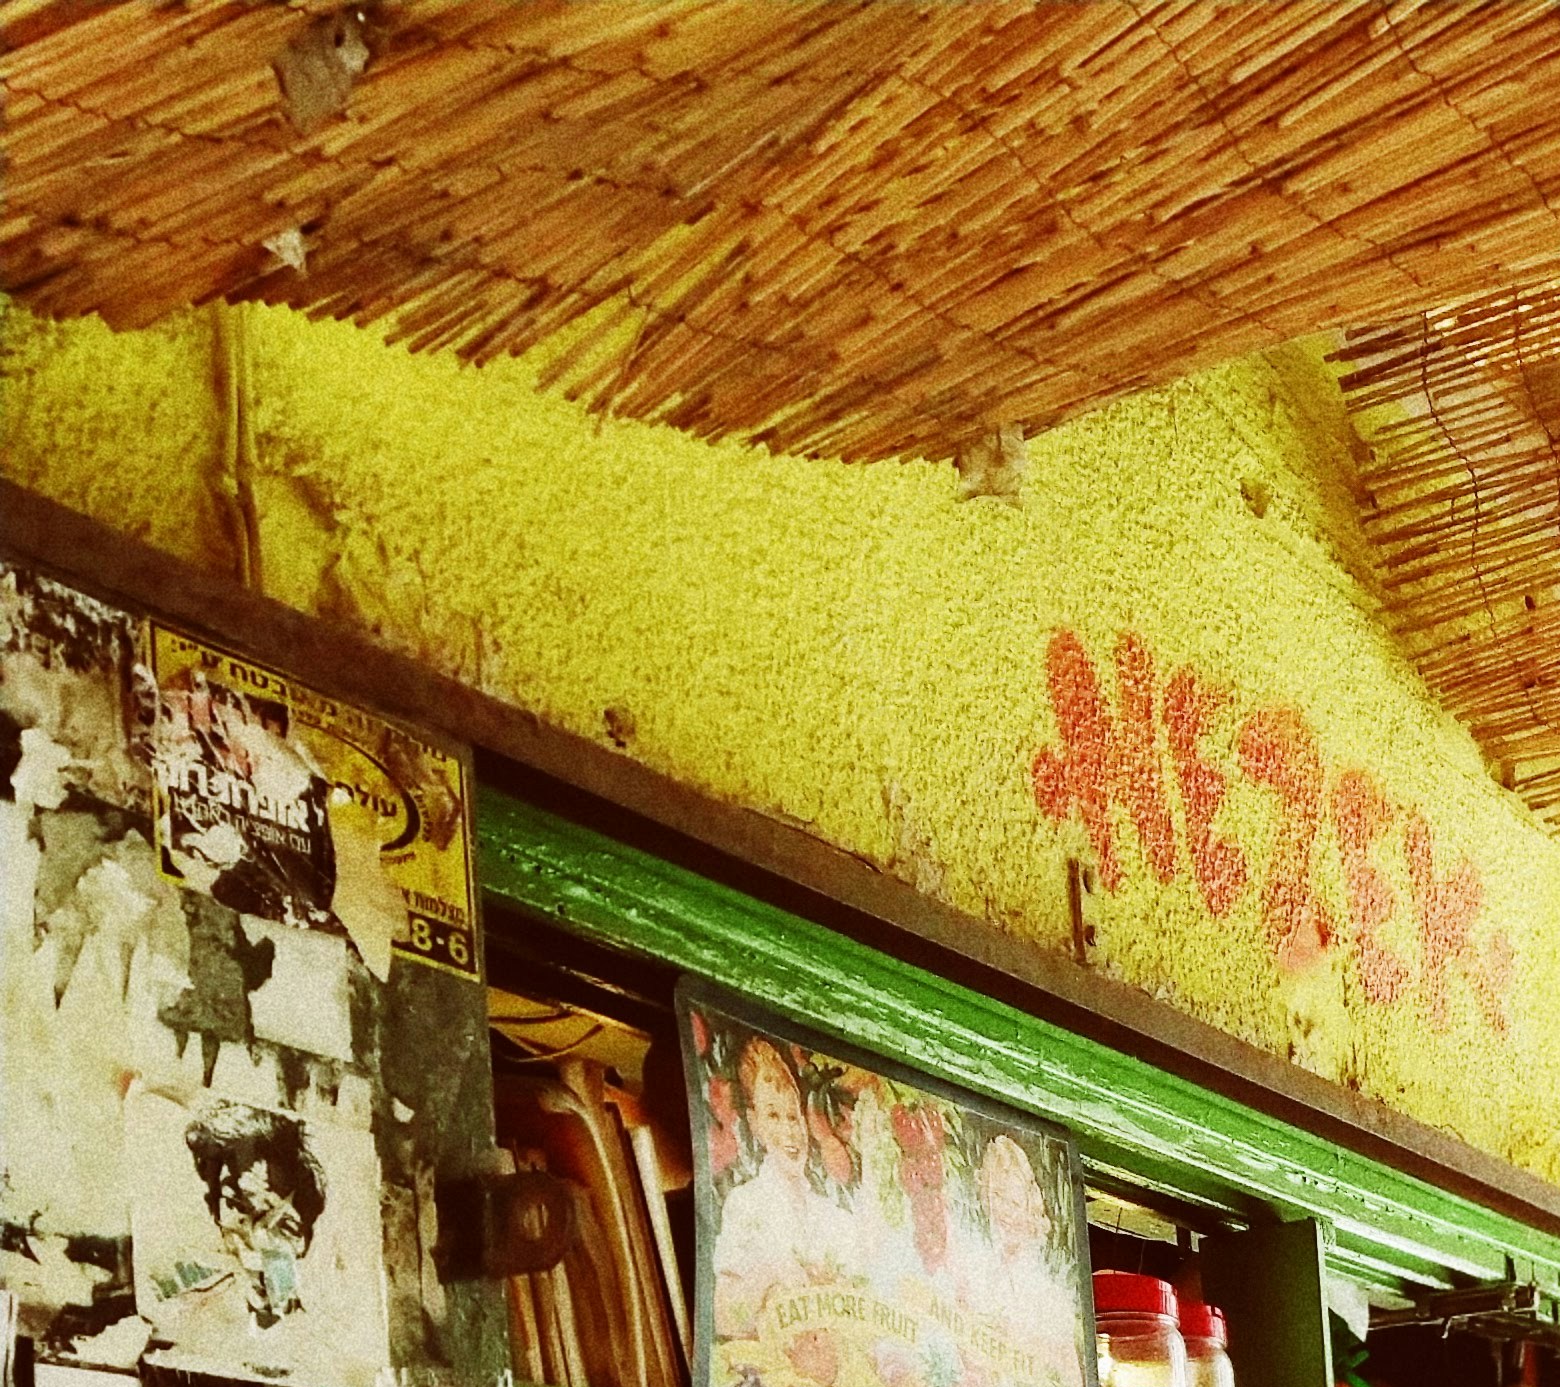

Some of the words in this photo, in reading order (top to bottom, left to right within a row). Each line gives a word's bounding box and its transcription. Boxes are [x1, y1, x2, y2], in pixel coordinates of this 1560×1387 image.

[775, 1295, 810, 1329] EAT
[817, 1293, 865, 1321] MORE
[872, 1300, 918, 1343] FRUIT
[929, 1295, 964, 1335] AND
[970, 1327, 1006, 1361] KEEP
[1013, 1350, 1035, 1376] FIT
